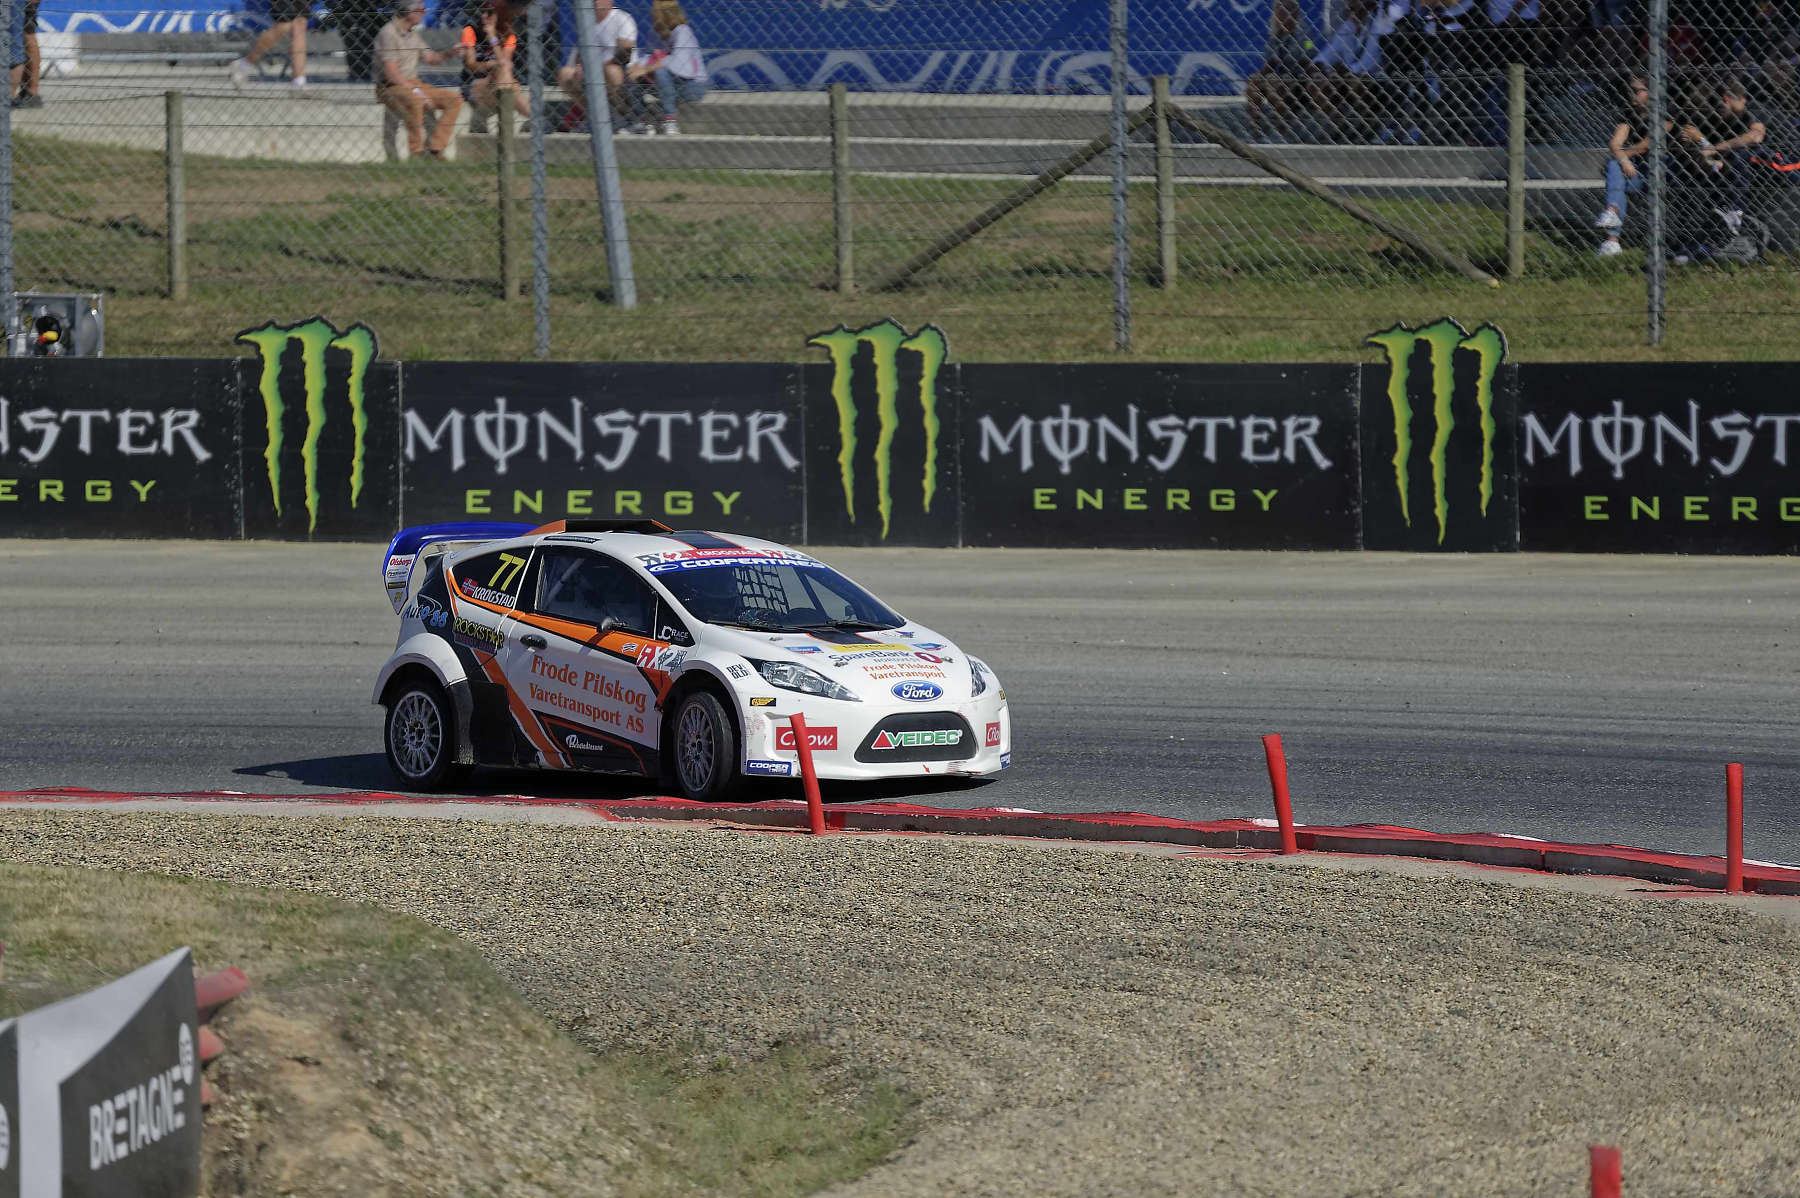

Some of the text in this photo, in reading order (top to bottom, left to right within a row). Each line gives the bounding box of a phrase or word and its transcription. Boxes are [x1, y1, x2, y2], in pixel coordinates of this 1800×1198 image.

[465, 489, 742, 516] ENERGY
[1033, 487, 1279, 511] ENERGY
[1584, 495, 1800, 522] ENERG
[487, 552, 527, 591] 77
[472, 586, 516, 608] KROGSTAD
[862, 663, 941, 672] Frode Pilskog
[869, 671, 946, 680] Varetransport
[530, 654, 648, 714] Frode Pilskog
[901, 684, 935, 699] Ford
[529, 682, 645, 734] Varetransport AS
[888, 730, 961, 747] VEIDEC
[88, 1064, 186, 1171] BRETAGNE
